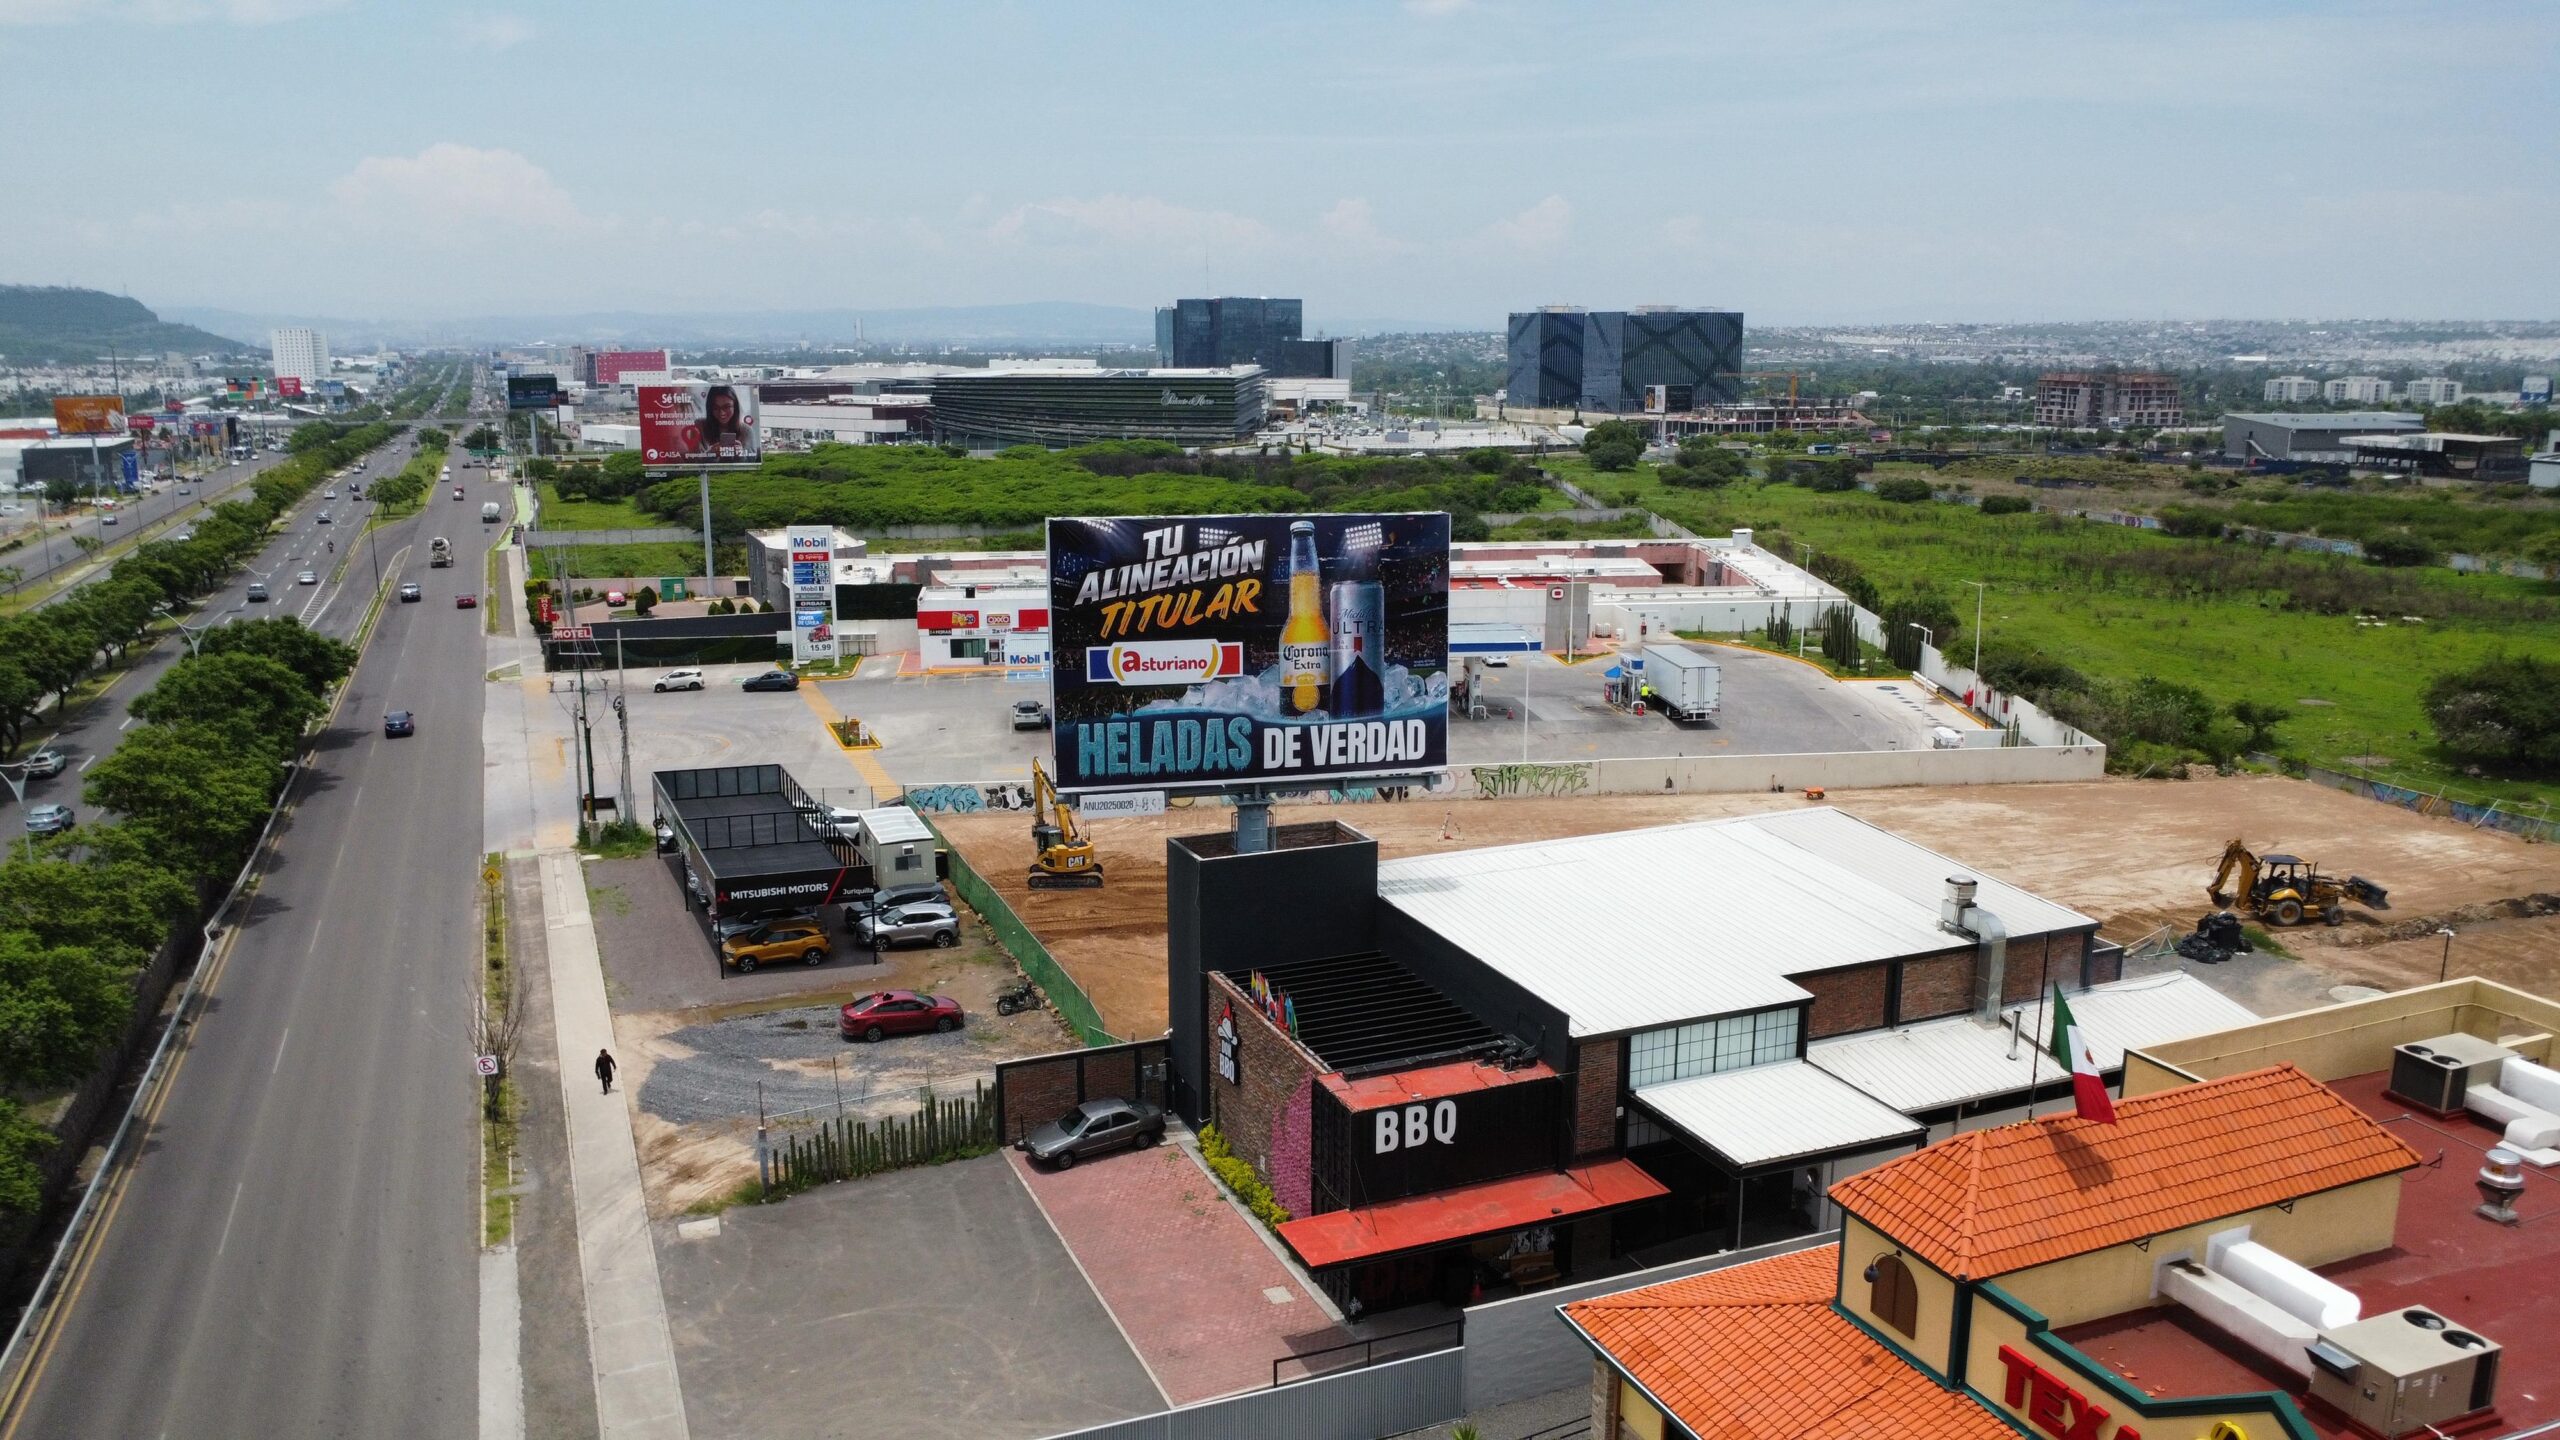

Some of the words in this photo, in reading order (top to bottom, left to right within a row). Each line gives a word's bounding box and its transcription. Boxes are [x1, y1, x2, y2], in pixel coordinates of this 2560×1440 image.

[793, 537, 827, 548] Mobil
[1142, 524, 1186, 561] TU
[1074, 535, 1268, 606] ALINEACIÓN
[988, 615, 1010, 623] OXXO
[1099, 578, 1264, 639] TITULAR
[554, 630, 590, 639] MOTEL
[1009, 654, 1040, 664] Mobil
[1121, 648, 1208, 673] asturiano
[1283, 644, 1330, 663] Corona
[1293, 659, 1321, 670] Extra
[1077, 717, 1252, 778] HELADAS
[1263, 727, 1302, 770] DE
[1309, 718, 1426, 767] VERDAD
[1067, 856, 1085, 868] CAT
[730, 887, 787, 900] MITSUBISHI
[788, 882, 829, 895] MOTORS
[842, 887, 875, 896] Juriquilla
[1219, 1052, 1235, 1085] BBQ
[1375, 1100, 1457, 1155] BBQ
[1998, 1344, 2142, 1440] TEX
